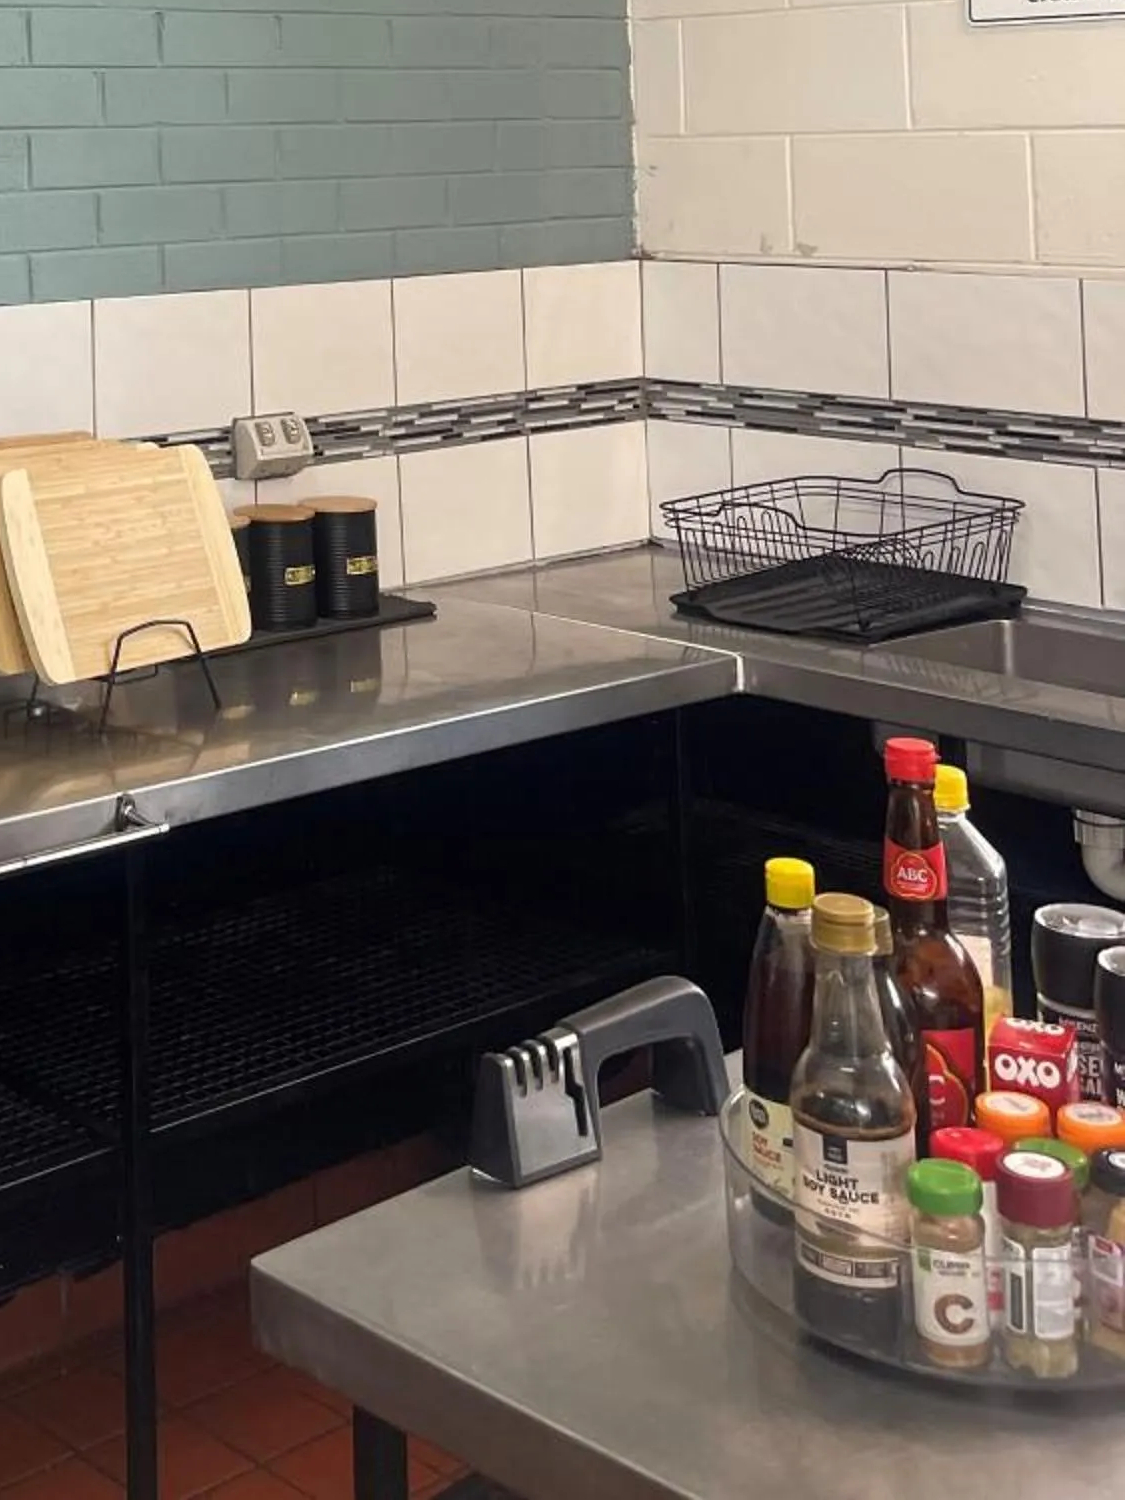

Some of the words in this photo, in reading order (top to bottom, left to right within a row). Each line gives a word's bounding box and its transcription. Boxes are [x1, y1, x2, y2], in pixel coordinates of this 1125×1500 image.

[897, 865, 928, 883] ABC
[994, 1053, 1061, 1090] OXO
[816, 1169, 860, 1191] LIGHT
[829, 1186, 880, 1205] SAUCE
[934, 1293, 975, 1335] C
